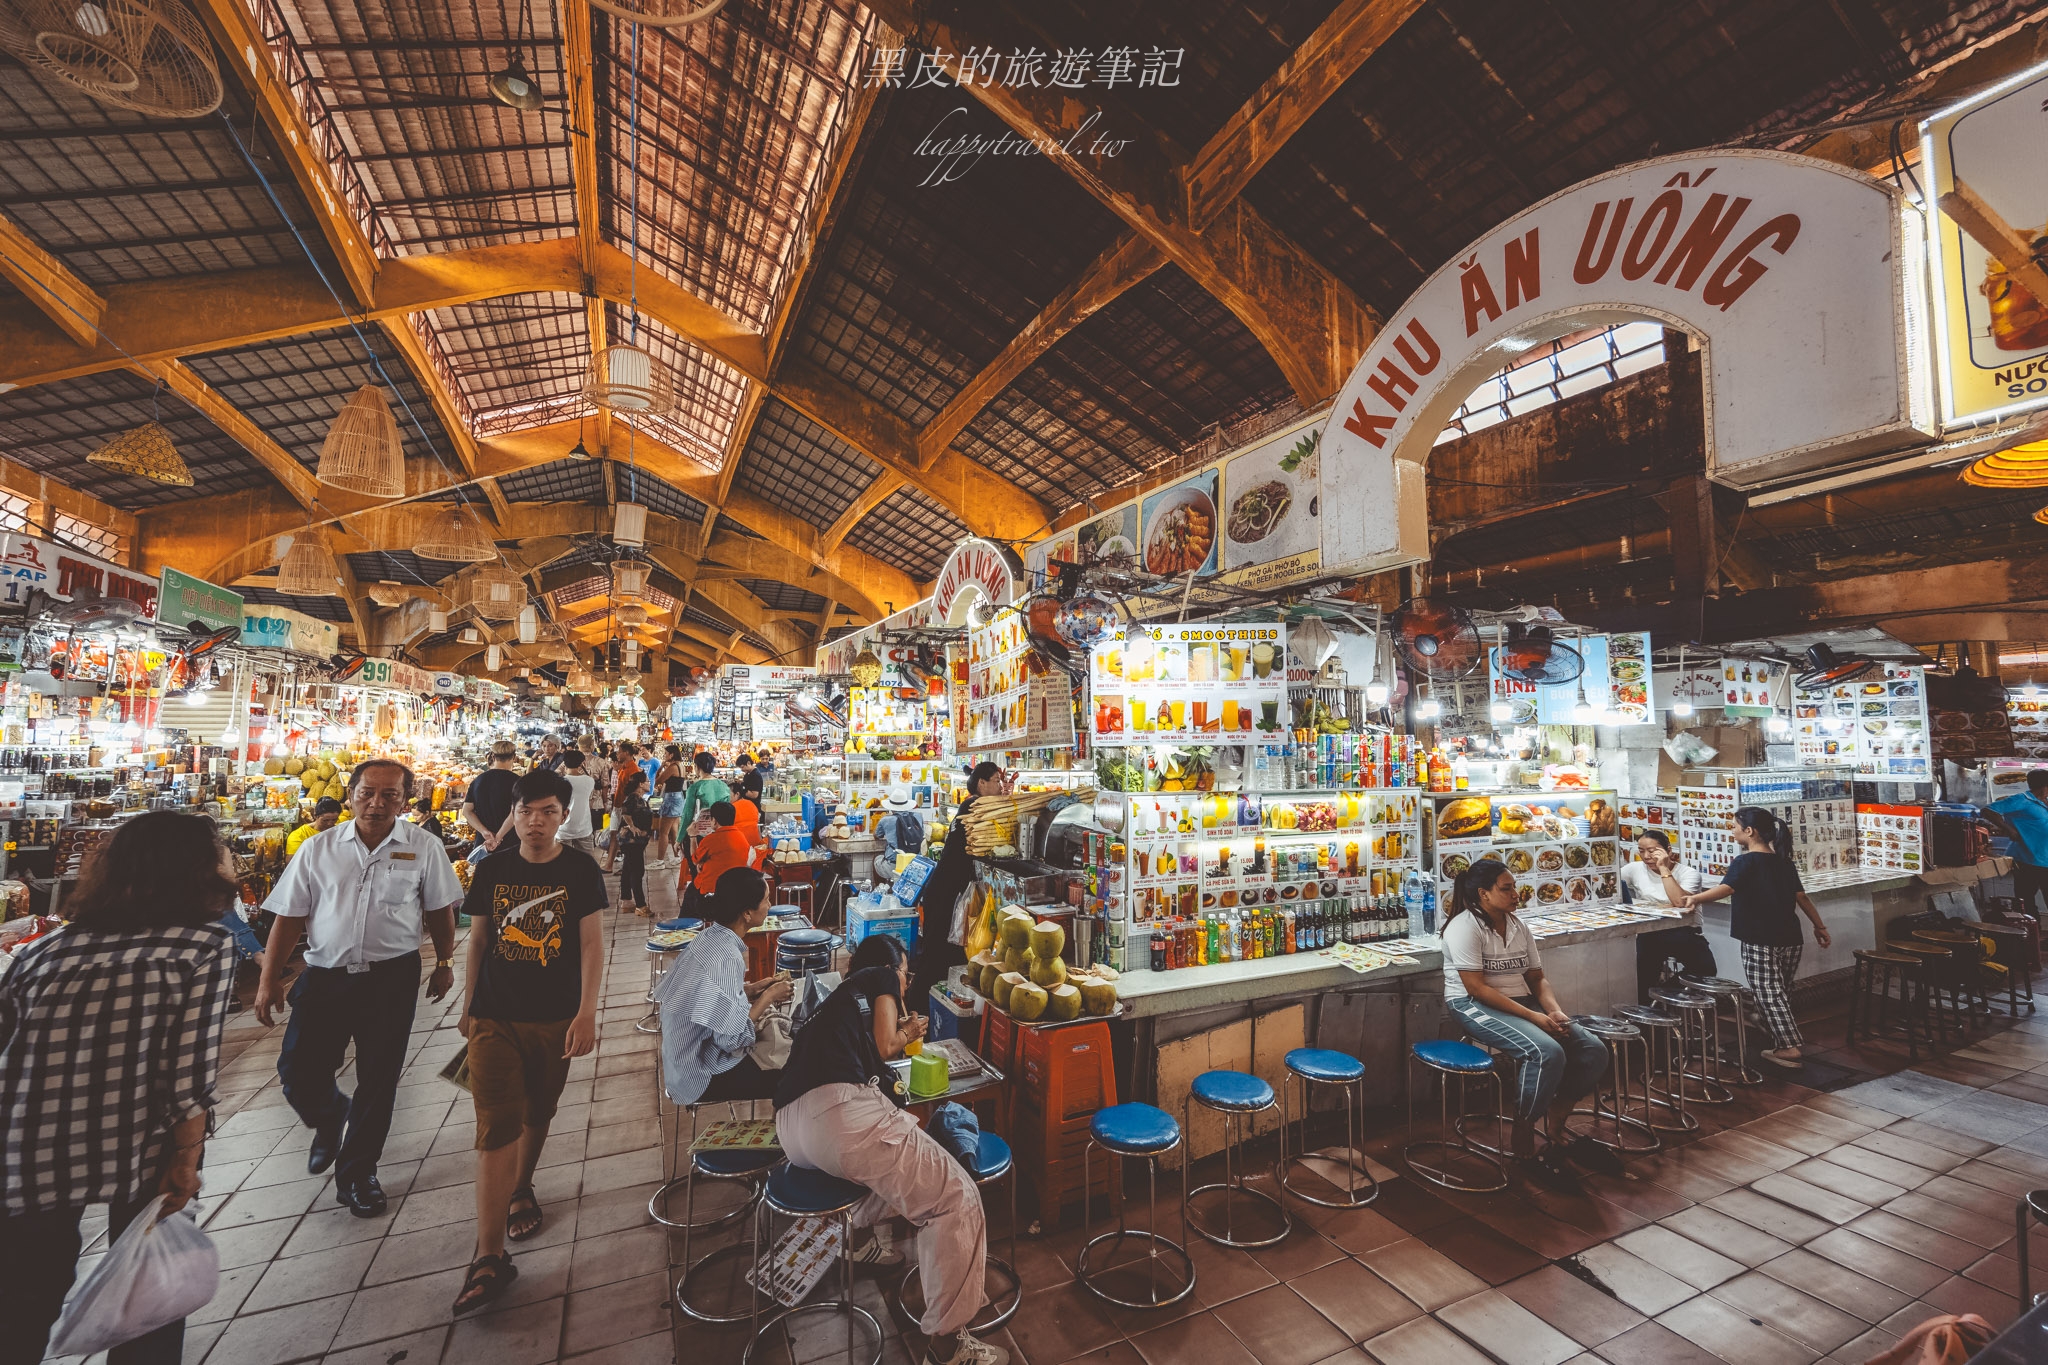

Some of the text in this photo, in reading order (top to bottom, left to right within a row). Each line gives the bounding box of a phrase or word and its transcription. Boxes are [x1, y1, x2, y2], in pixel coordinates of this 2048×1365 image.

[1343, 168, 1801, 449] KHU ĂN UỐNG
[1275, 562, 1289, 572] PHỞ
[1291, 558, 1300, 568] BÒ
[1257, 574, 1272, 584] BEEF
[1274, 566, 1305, 580] NOODLES
[937, 549, 1006, 621] KHU ĂN UỐNG
[182, 611, 197, 620] FRUITS
[1181, 629, 1278, 640] SMOOTHIES
[494, 884, 568, 900] PUMA
[1242, 930, 1252, 941] C2
[1254, 929, 1264, 940] C2
